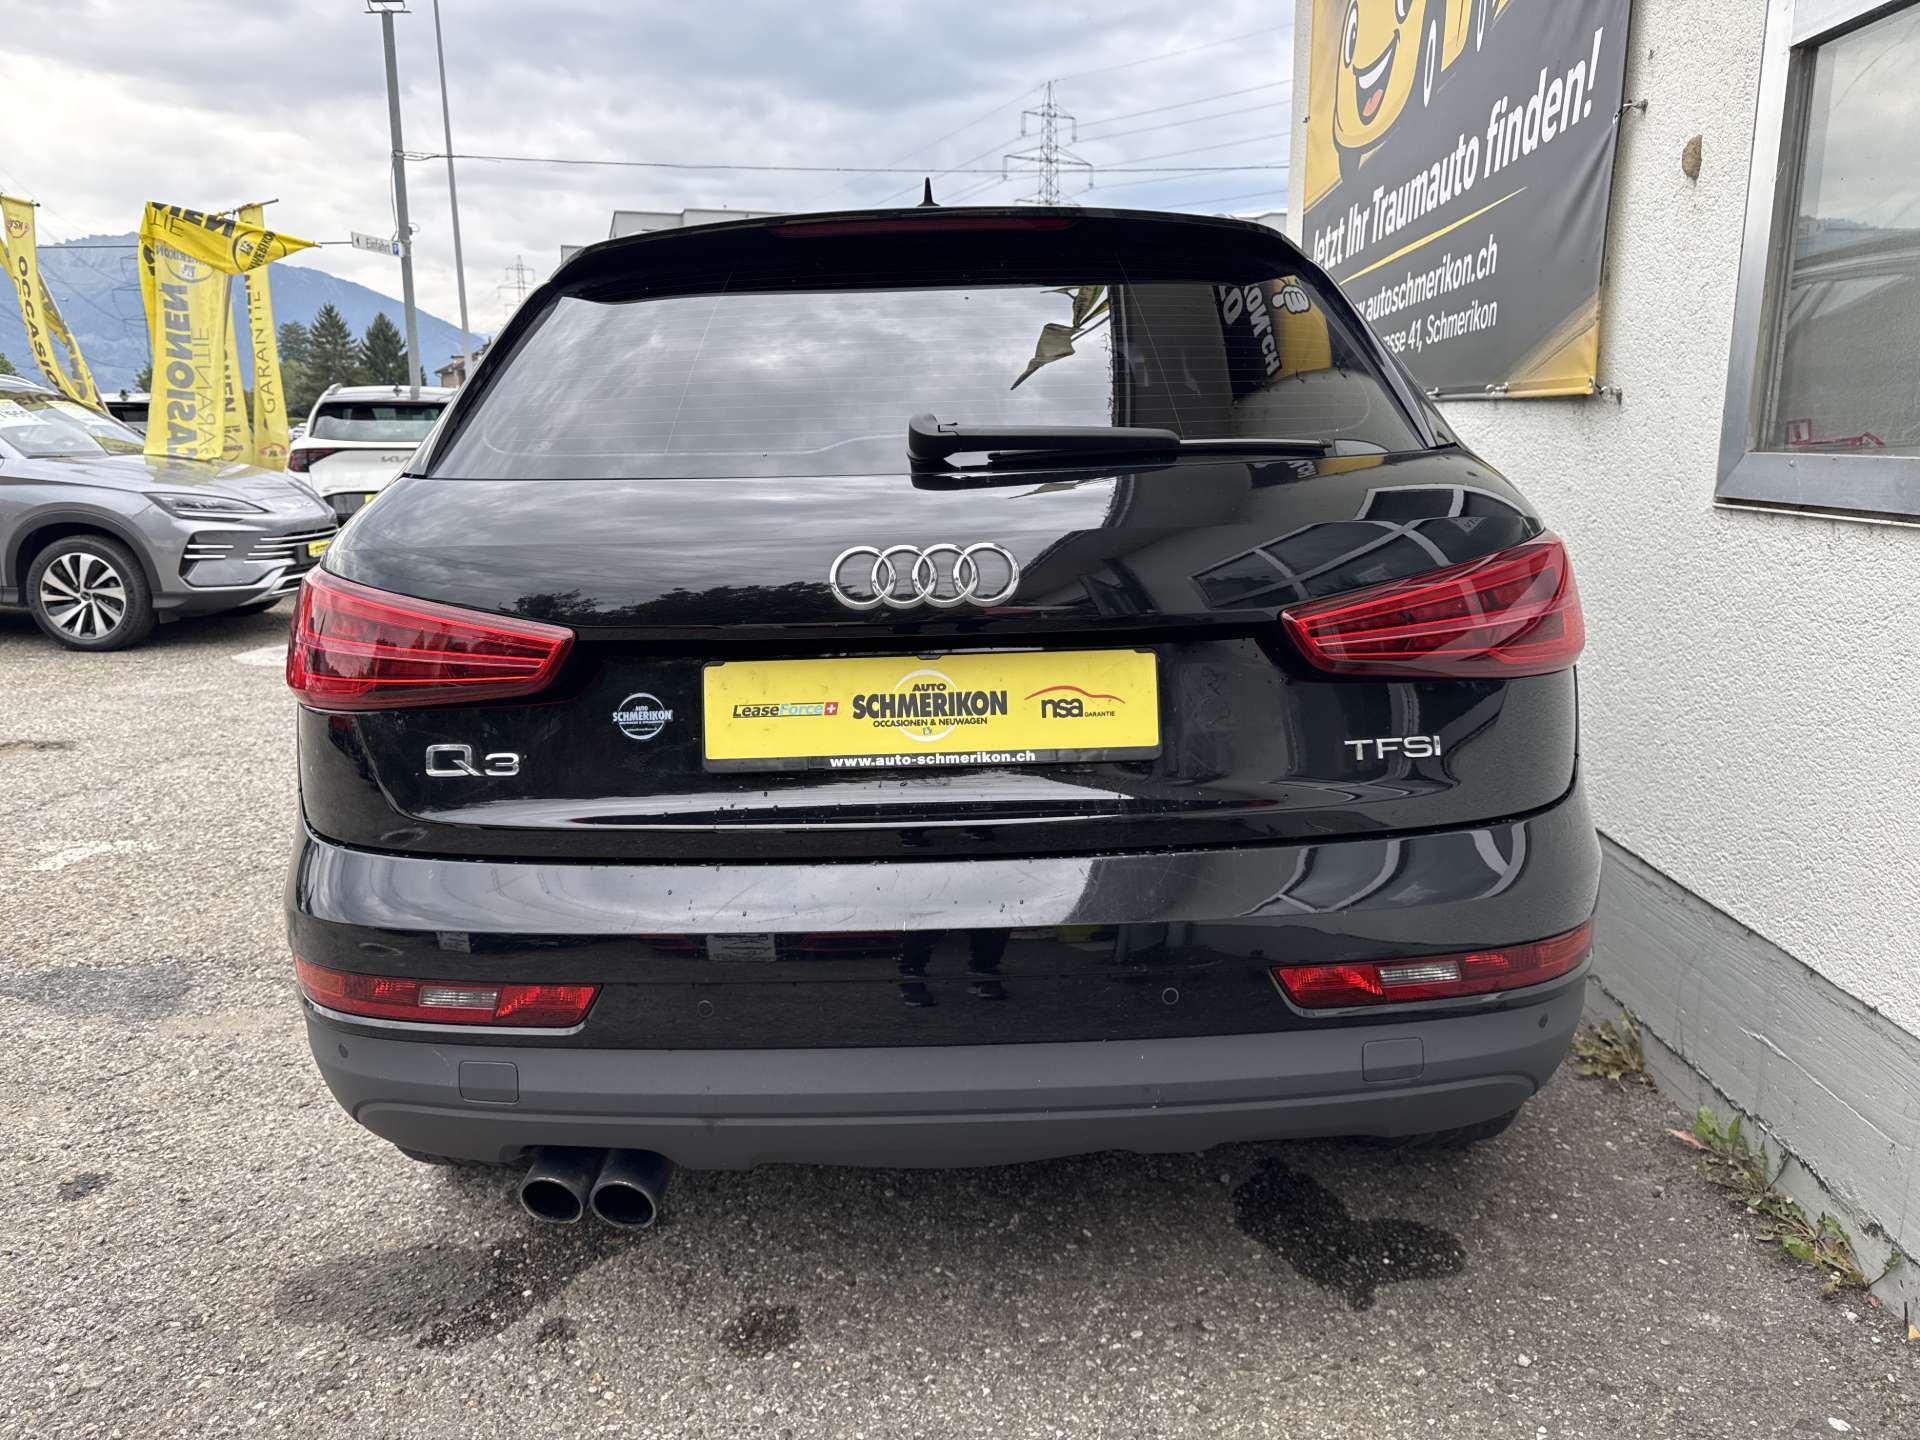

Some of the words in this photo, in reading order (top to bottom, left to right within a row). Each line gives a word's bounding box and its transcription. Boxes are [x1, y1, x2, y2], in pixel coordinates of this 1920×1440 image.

[1313, 217, 1345, 270] Jetzt
[1346, 203, 1370, 258] Ihr
[1372, 133, 1480, 243] Traumauto
[1484, 27, 1603, 179] finden!
[1355, 234, 1498, 322] wautoschmerikon.ch
[18, 255, 67, 396] OCCASIO
[1407, 318, 1423, 353] 41,
[1426, 300, 1498, 345] Schmerikon
[912, 683, 947, 692] AUTO
[612, 710, 673, 722] SCHMERIKON
[733, 703, 824, 717] LeaseForce
[852, 690, 1008, 719] SCHMERIKON
[1041, 698, 1083, 718] nsa
[1084, 710, 1116, 718] GARANTIE
[873, 718, 928, 728] OCCASIONEN
[930, 718, 936, 726] &
[938, 717, 988, 726] NEUWAGEN
[829, 750, 1036, 768] www.auto-schmerikon.ch
[1343, 735, 1442, 761] TFSI
[425, 743, 520, 777] Q3
